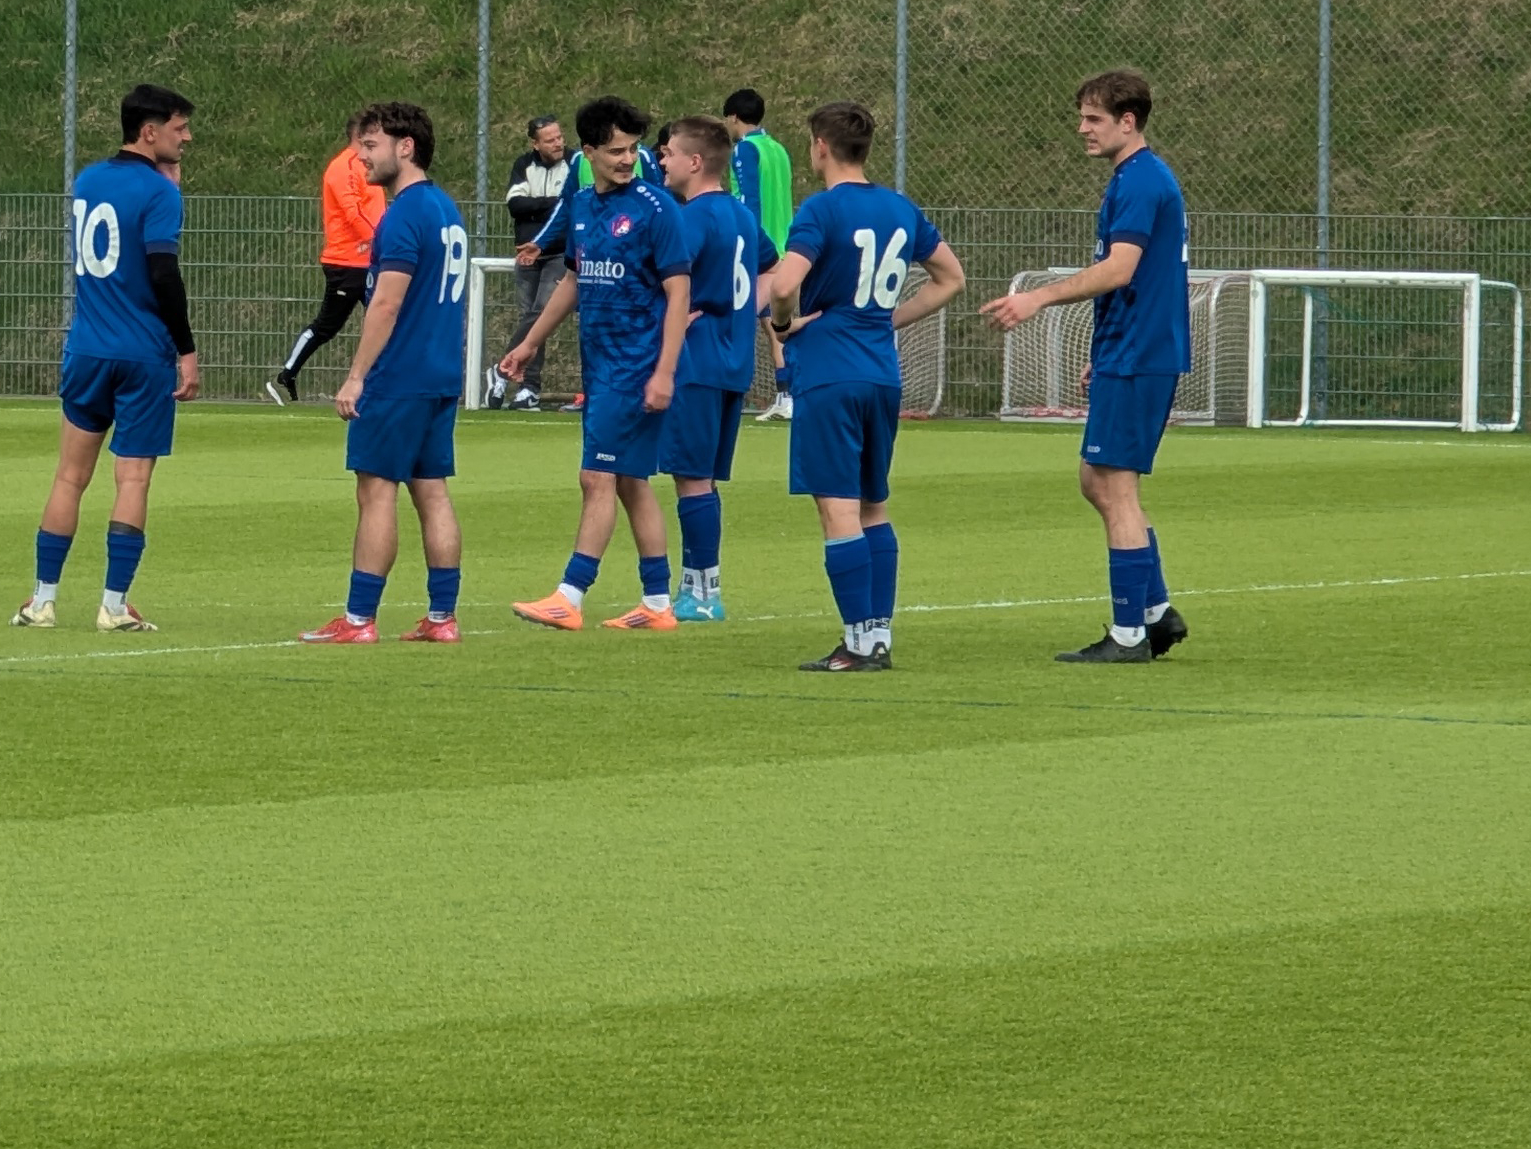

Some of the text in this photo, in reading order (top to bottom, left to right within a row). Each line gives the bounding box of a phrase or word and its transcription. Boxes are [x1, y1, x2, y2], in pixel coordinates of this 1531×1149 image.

[73, 198, 121, 279] 10
[438, 224, 468, 304] 19
[733, 235, 751, 311] 6
[853, 227, 908, 310] 16
